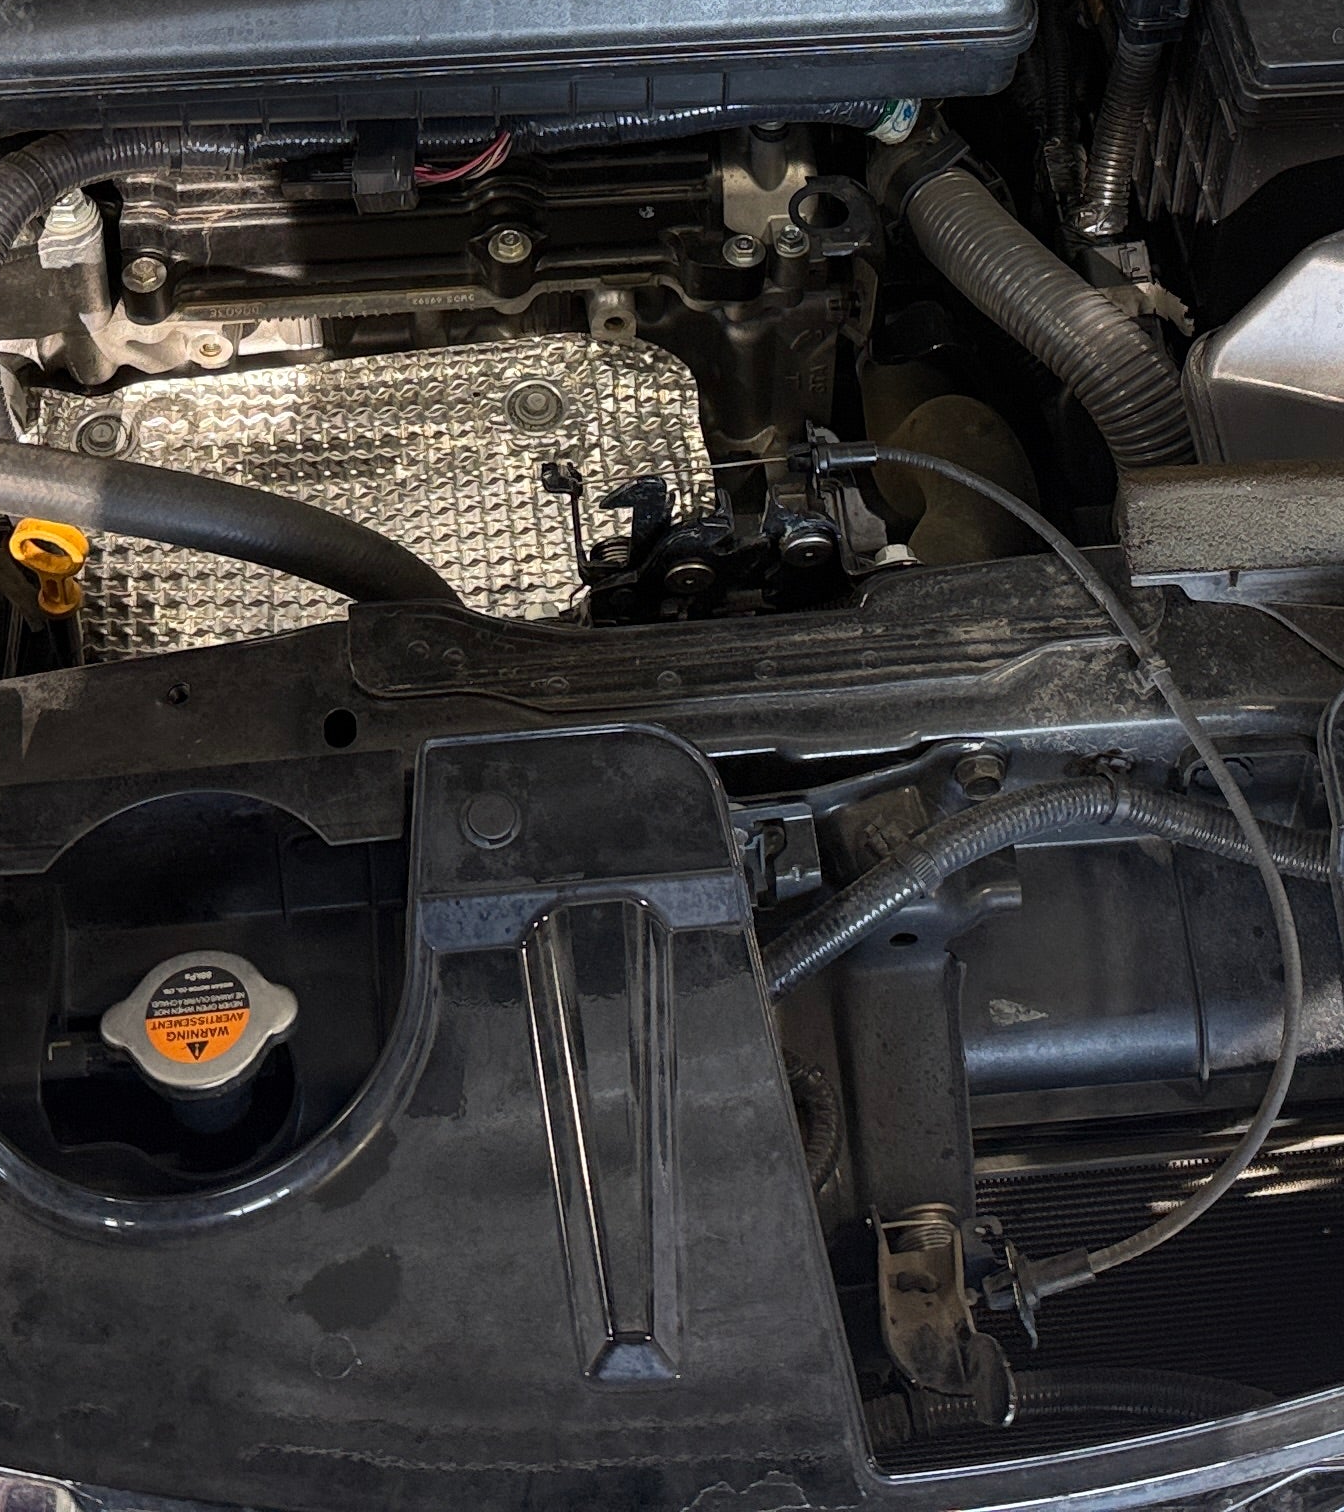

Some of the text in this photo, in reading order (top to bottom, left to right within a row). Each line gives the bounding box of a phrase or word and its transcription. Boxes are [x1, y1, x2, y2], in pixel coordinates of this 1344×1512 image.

[196, 1003, 218, 1011] OPEN
[218, 1000, 243, 1009] NEVER
[171, 1005, 195, 1015] WHEN
[150, 1012, 244, 1030] AVERTISSEMENT
[166, 1026, 230, 1041] WARNING
